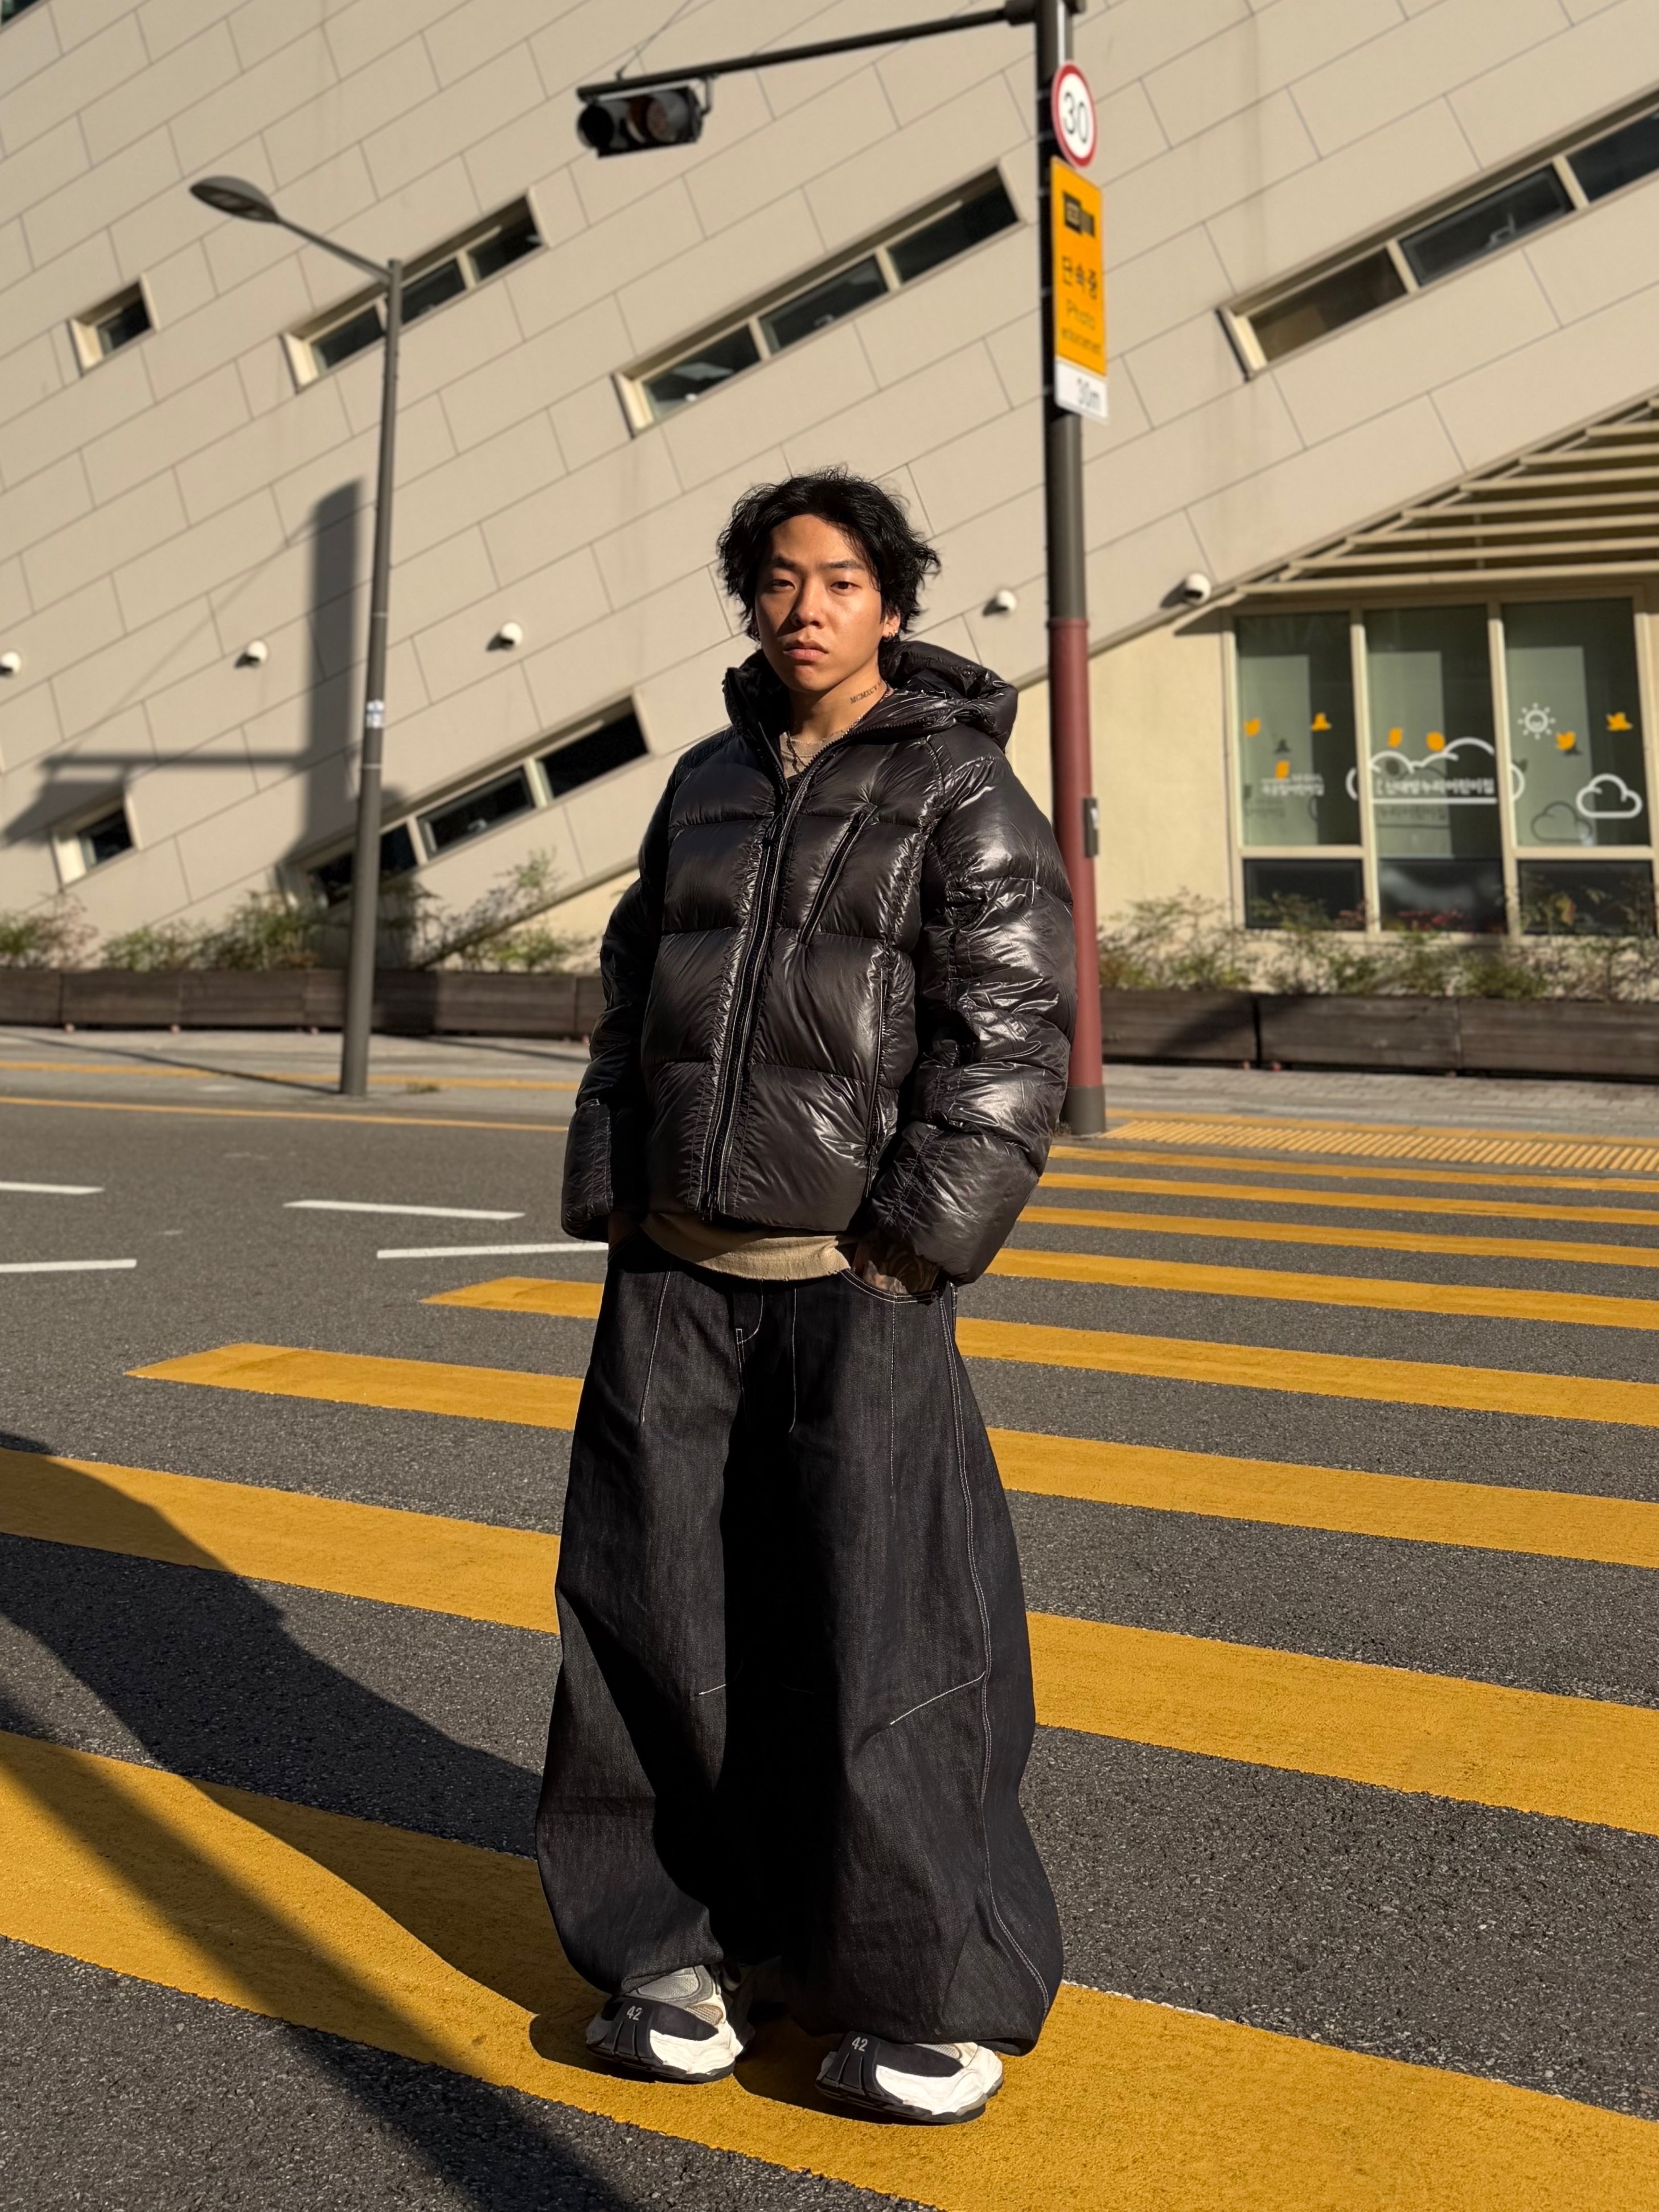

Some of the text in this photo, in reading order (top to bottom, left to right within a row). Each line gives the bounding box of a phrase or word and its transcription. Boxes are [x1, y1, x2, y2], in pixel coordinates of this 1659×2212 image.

[1063, 91, 1089, 143] 30
[1062, 256, 1098, 300] 단속중
[626, 2005, 643, 2021] 42
[851, 2037, 868, 2051] 42
